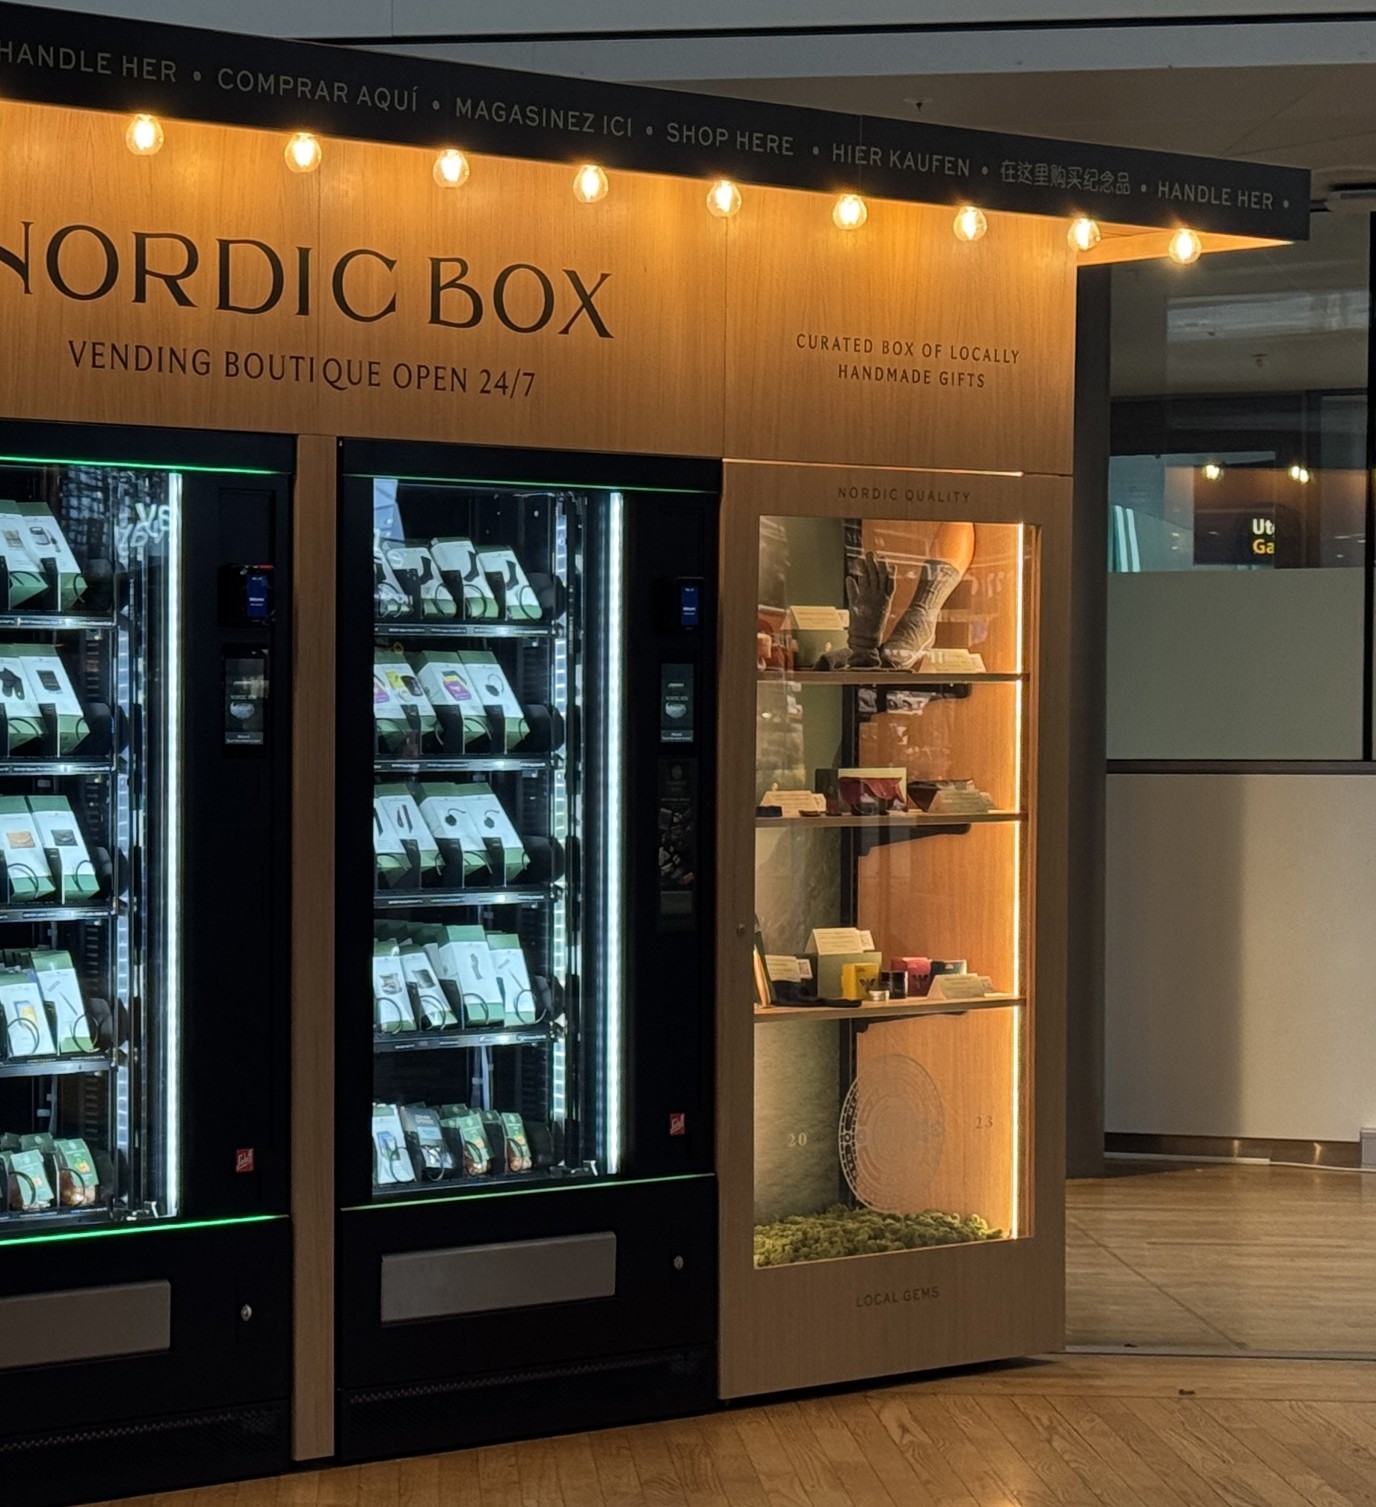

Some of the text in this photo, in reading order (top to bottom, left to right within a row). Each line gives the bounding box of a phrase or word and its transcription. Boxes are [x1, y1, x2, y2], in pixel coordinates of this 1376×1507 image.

[121, 55, 176, 82] HER
[217, 67, 418, 112] COMPRAR AQUÍ
[455, 96, 632, 138] MAGASINEZ ICI
[666, 122, 795, 156] SHOP HERE
[832, 143, 970, 178] HIER KAUFEN
[1000, 159, 1131, 195] 在这里购买纪念品
[1158, 180, 1274, 210] HANDLE HER
[428, 256, 614, 339] BOX
[797, 333, 1020, 365] CURATED BOX OF LOCALLY
[68, 339, 536, 400] VENDING BOUTIQUE OPEN 24/7
[838, 364, 986, 388] HANDMADE GIFTS
[838, 486, 971, 503] NORDIC QUALITY
[975, 1114, 994, 1130] 23
[787, 1131, 808, 1147] 20
[855, 1285, 940, 1309] LOCAL GEMS
